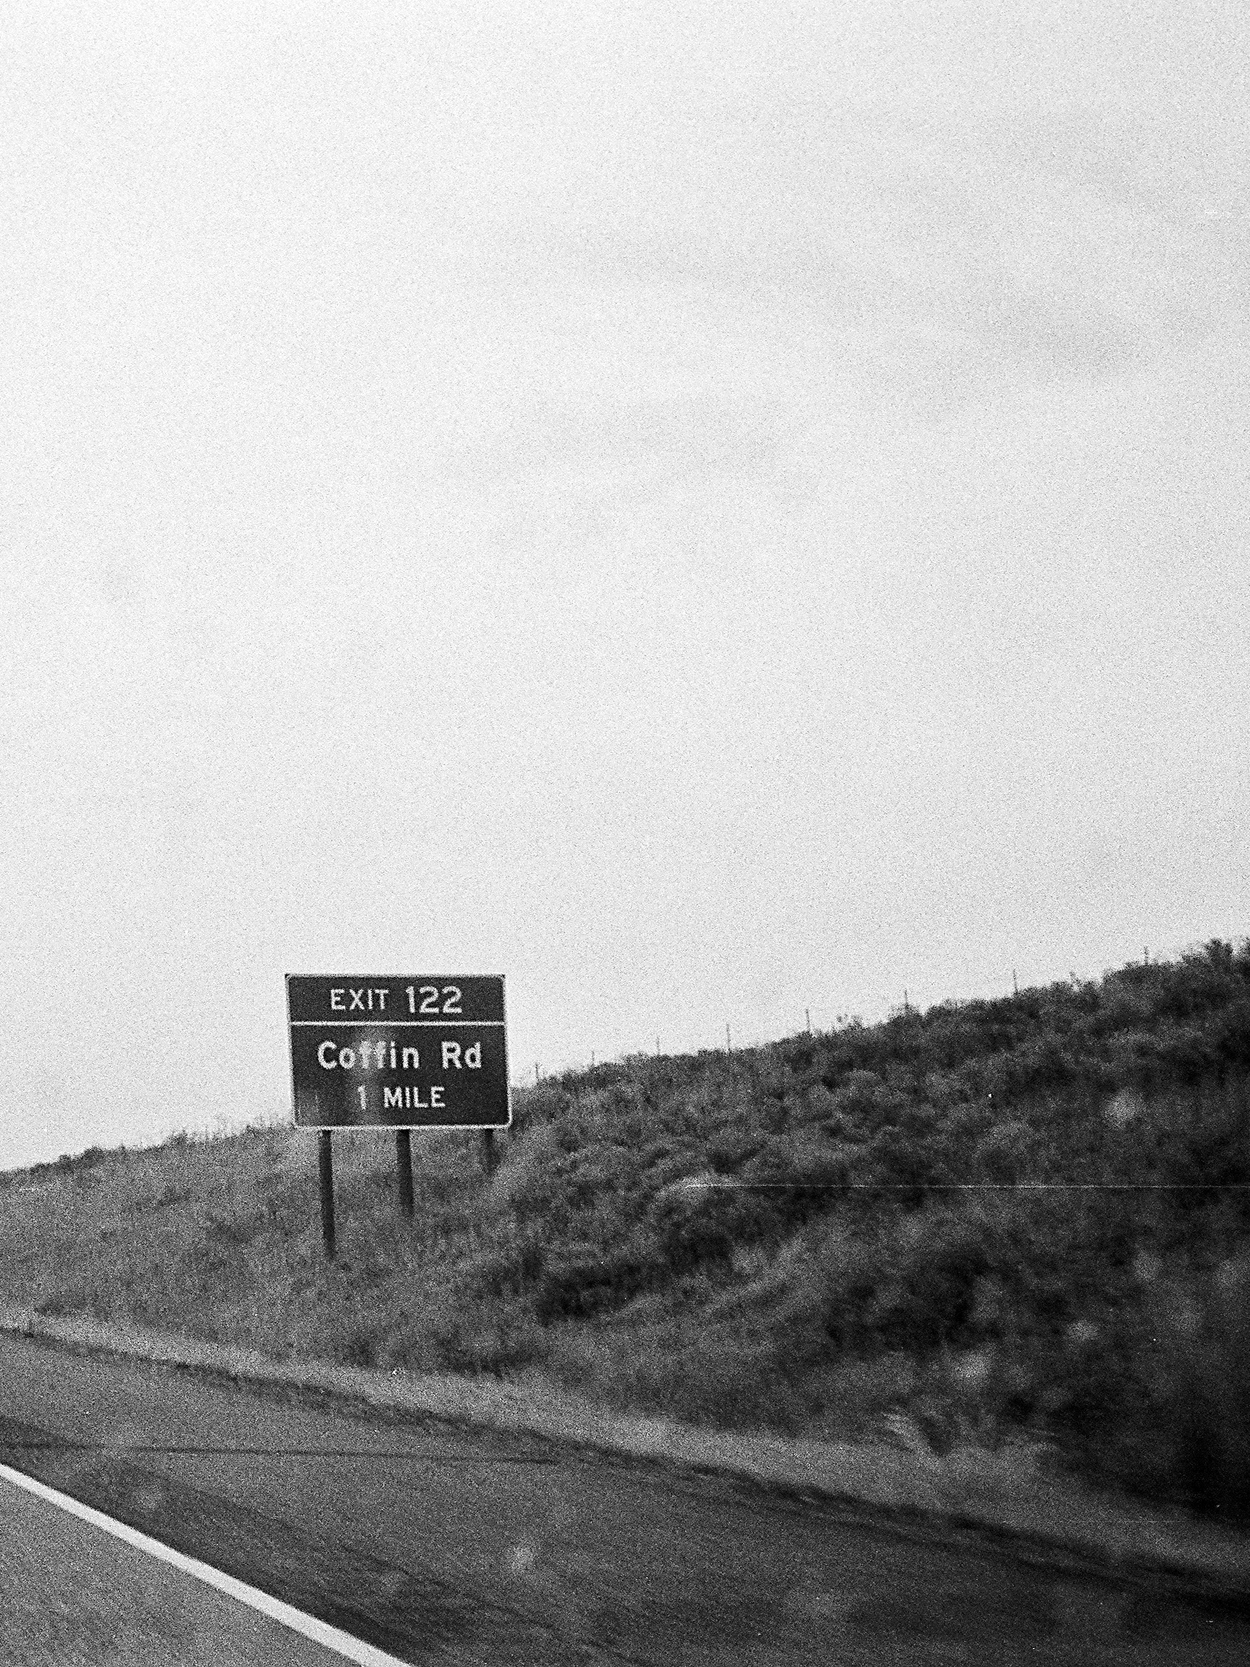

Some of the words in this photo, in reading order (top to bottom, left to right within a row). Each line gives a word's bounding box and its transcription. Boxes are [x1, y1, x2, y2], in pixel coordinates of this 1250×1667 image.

[330, 988, 389, 1010] EXIT
[405, 985, 462, 1014] 122
[317, 1040, 420, 1070] Coffin
[441, 1040, 482, 1069] Rd
[357, 1085, 366, 1110] 1
[383, 1086, 446, 1108] MILE
